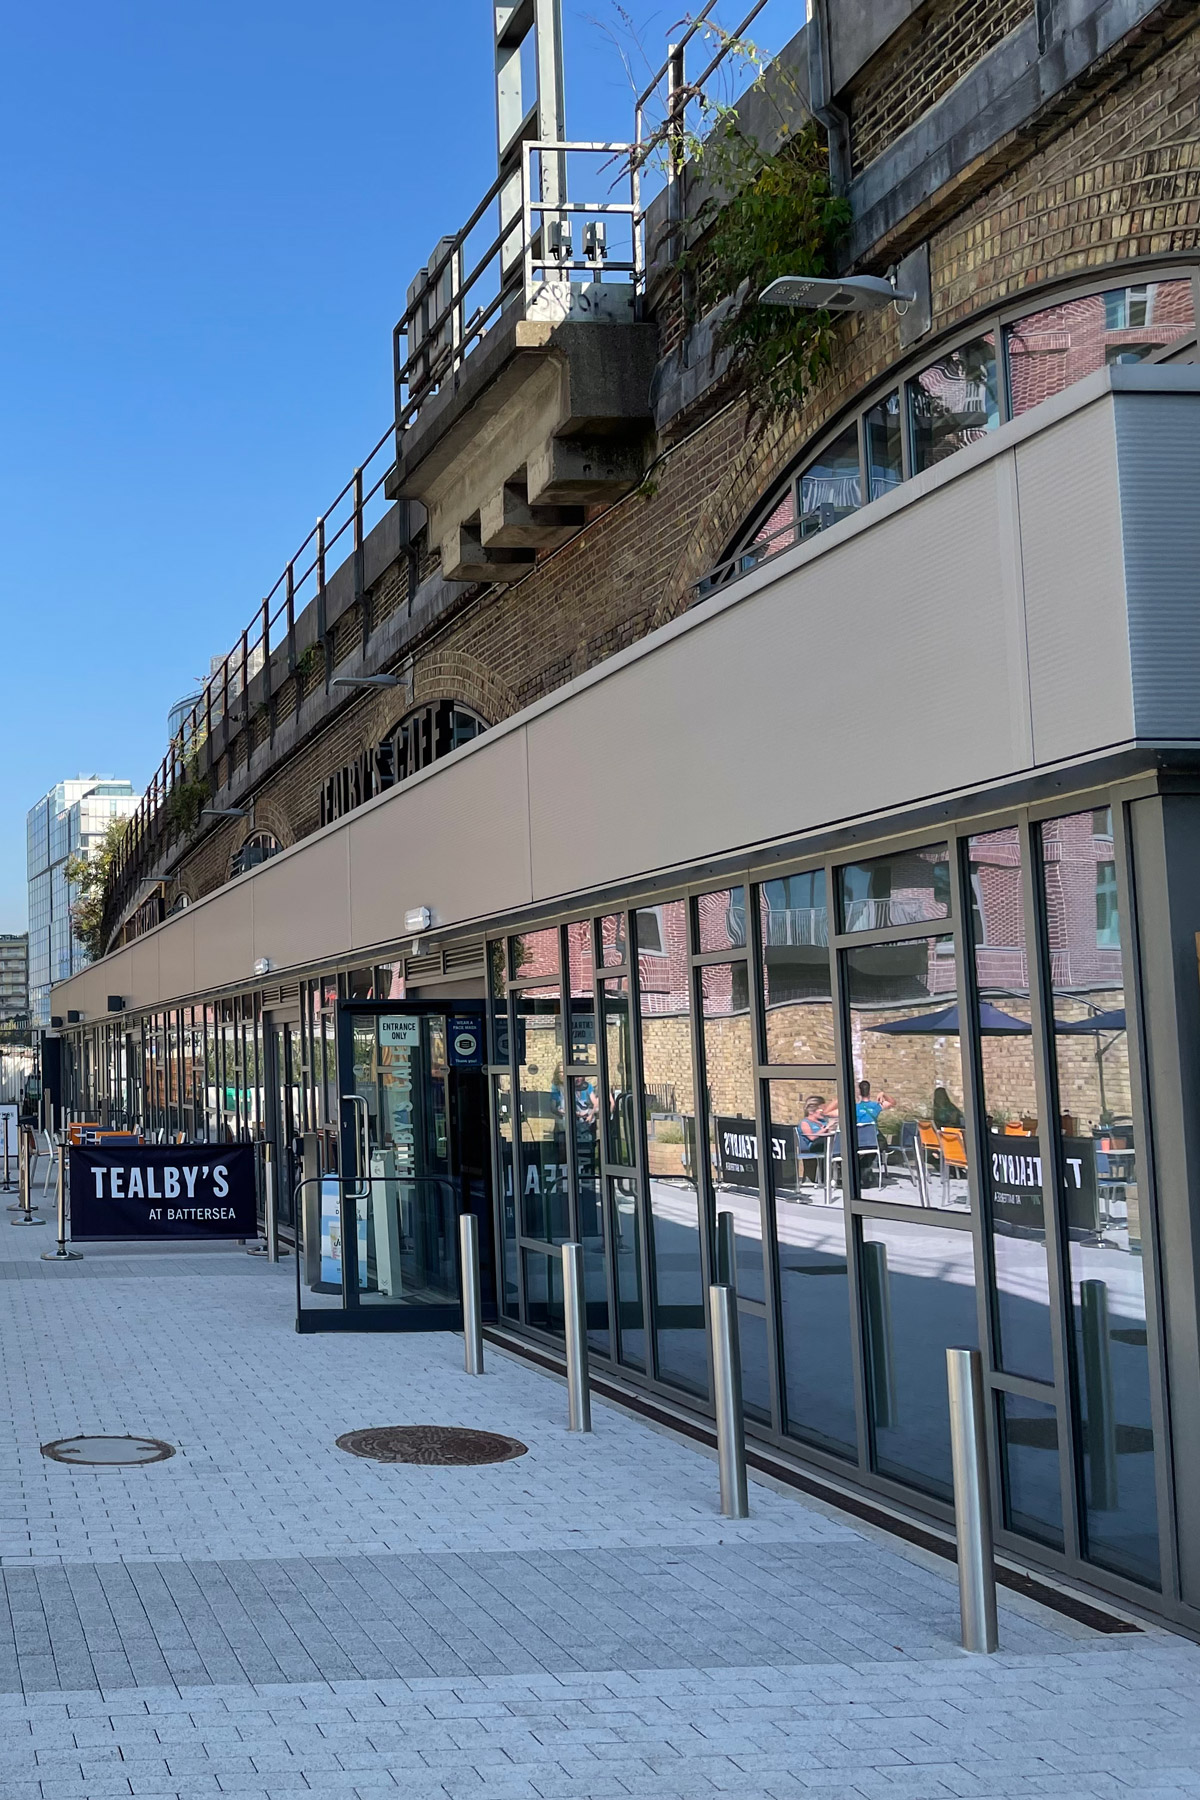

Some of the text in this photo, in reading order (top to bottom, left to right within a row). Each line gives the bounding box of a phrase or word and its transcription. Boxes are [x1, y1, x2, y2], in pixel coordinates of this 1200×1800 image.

[382, 1022, 416, 1031] ENTRANCE
[391, 1031, 407, 1040] ONLY
[90, 1165, 229, 1199] TEALBY'S
[149, 1207, 236, 1220] AT BATTERSEA
